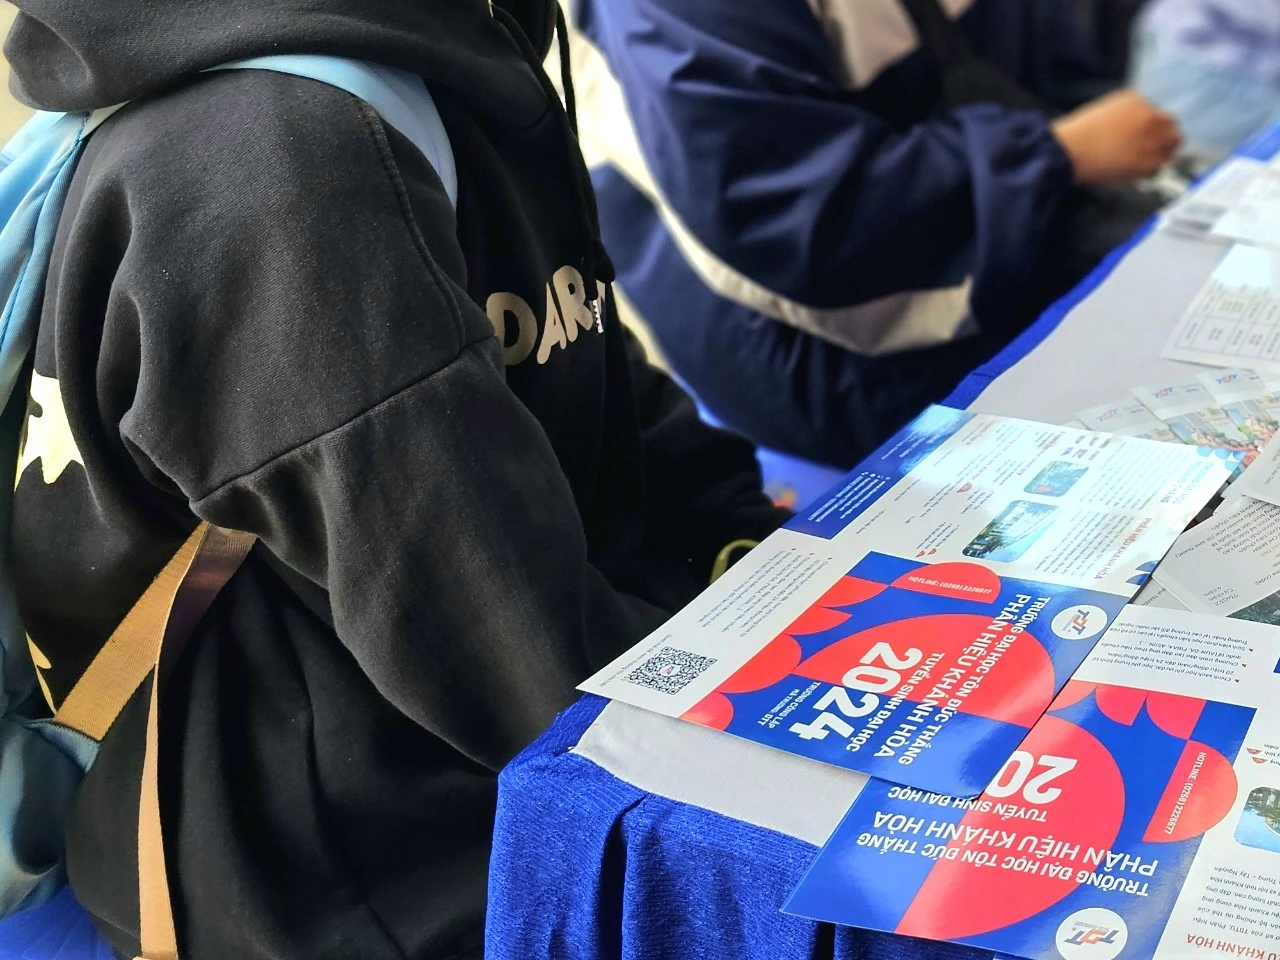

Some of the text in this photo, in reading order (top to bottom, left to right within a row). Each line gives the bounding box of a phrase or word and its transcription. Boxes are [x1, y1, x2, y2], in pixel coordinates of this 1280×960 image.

[768, 682, 822, 728] TRƯỜNG CÔNG LẬP
[788, 641, 923, 740] 2024
[846, 653, 945, 752] TUYỂN SINH ĐẠI HỌC
[873, 594, 1032, 756] PHÂN HIỆU KHÁNH HÒA
[898, 596, 1051, 765] TRƯỜNG ĐẠI HỌC TÔN ĐỨC THẮNG
[888, 786, 1047, 822] TUYỂN SINH ĐẠI HỌC
[1164, 752, 1207, 835] HOTLINE: (0258)2226677
[856, 833, 1148, 897] TRƯỜNG ĐẠI HỌC TÔN ĐỨC THẮNG
[874, 811, 1158, 876] PHÂN HIỆU KHÁNH HÒA
[1186, 934, 1266, 958] KHÁNH HÒA
